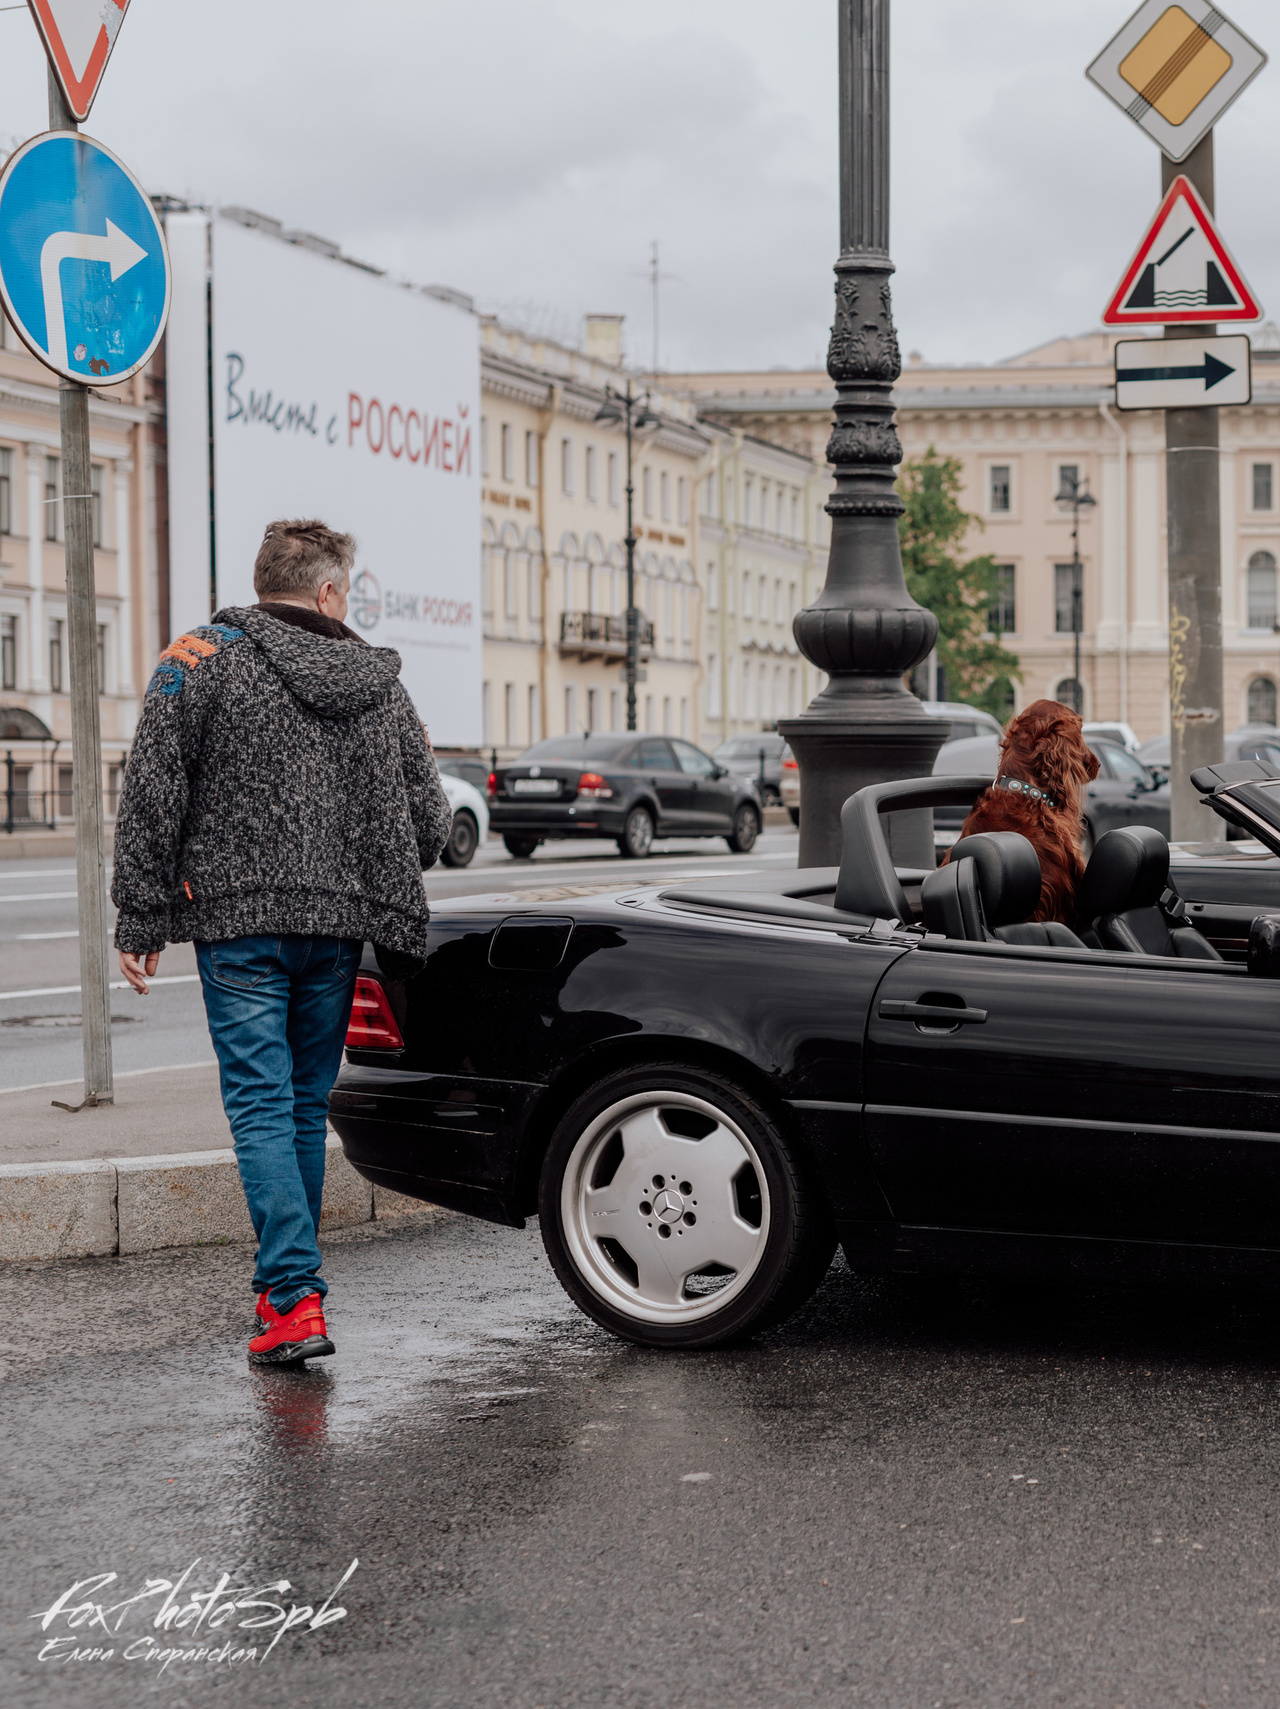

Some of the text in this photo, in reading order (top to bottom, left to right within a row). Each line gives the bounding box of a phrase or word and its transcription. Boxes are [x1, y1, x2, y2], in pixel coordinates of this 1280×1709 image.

[225, 352, 318, 436] Вместе
[348, 391, 473, 478] РОССИЕЙ
[385, 590, 474, 627] БАНК РОССИЯ
